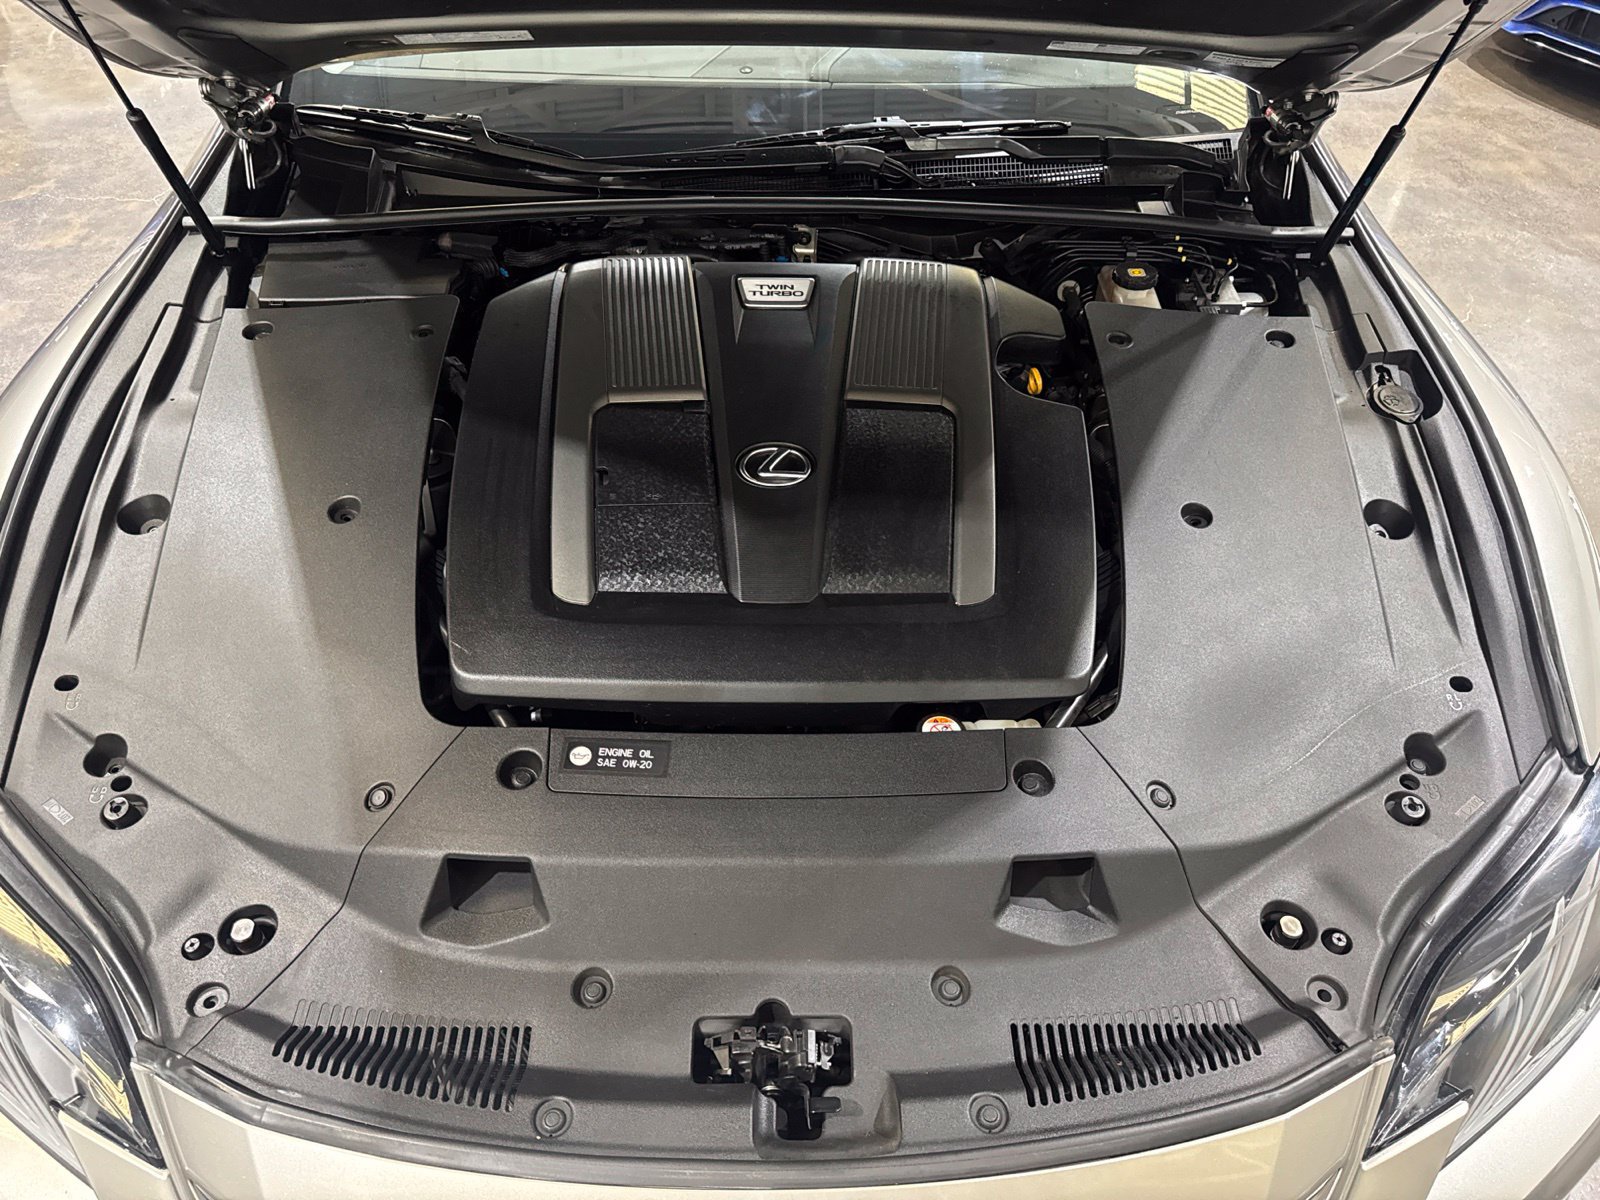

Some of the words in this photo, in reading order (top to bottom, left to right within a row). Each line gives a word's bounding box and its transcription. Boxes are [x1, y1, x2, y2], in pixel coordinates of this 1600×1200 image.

[598, 747, 634, 758] ENGINE
[639, 749, 654, 759] OIL
[596, 758, 617, 768] SAE
[622, 759, 653, 769] 0W-20
